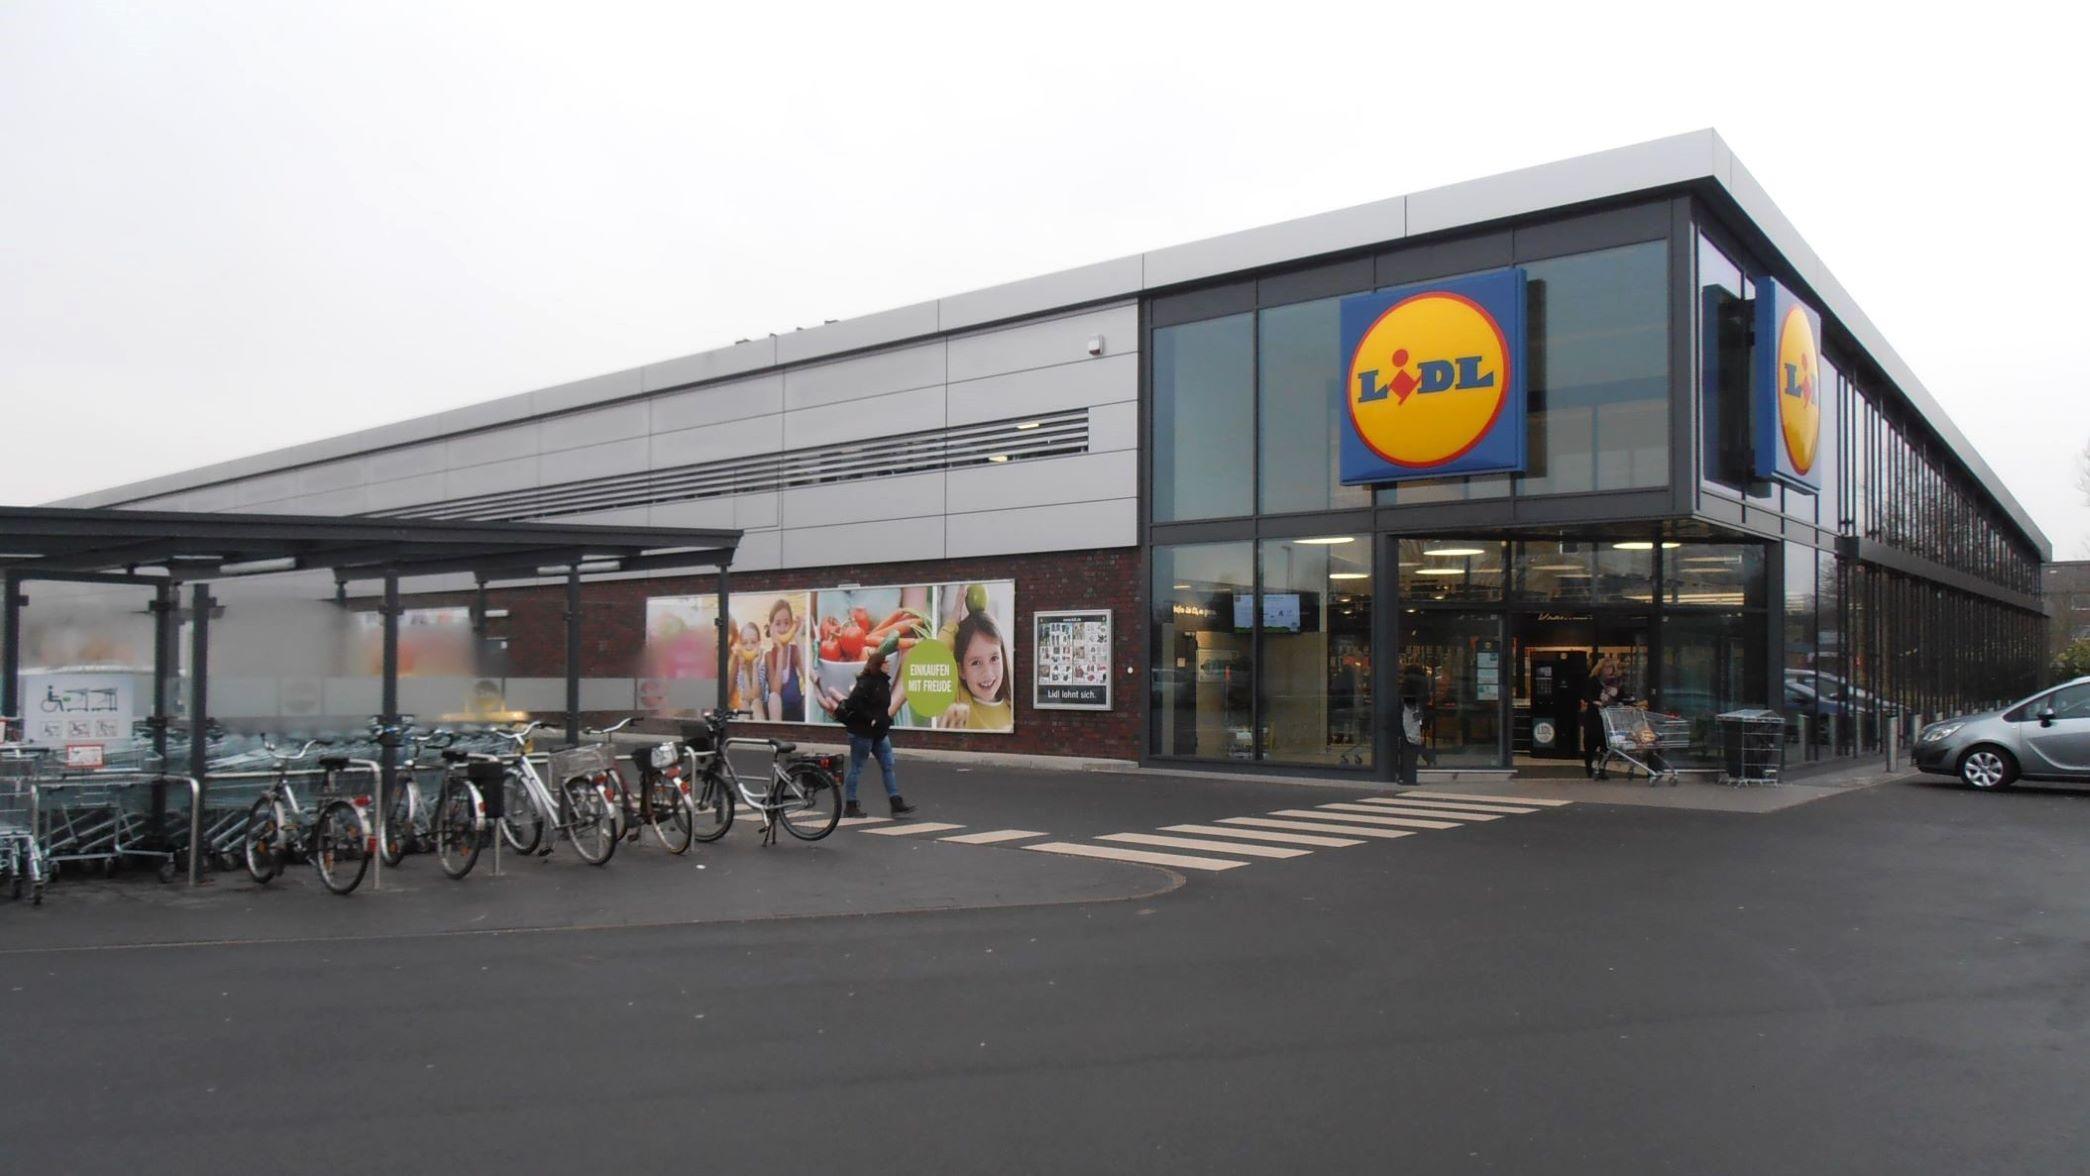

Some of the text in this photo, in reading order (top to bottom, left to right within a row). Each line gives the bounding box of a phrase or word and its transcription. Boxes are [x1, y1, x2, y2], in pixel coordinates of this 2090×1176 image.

[910, 663, 950, 676] EINKAUFEN
[908, 680, 952, 692] MIT FREUDE
[1047, 689, 1060, 698] Lidl
[1061, 689, 1079, 699] lohnt
